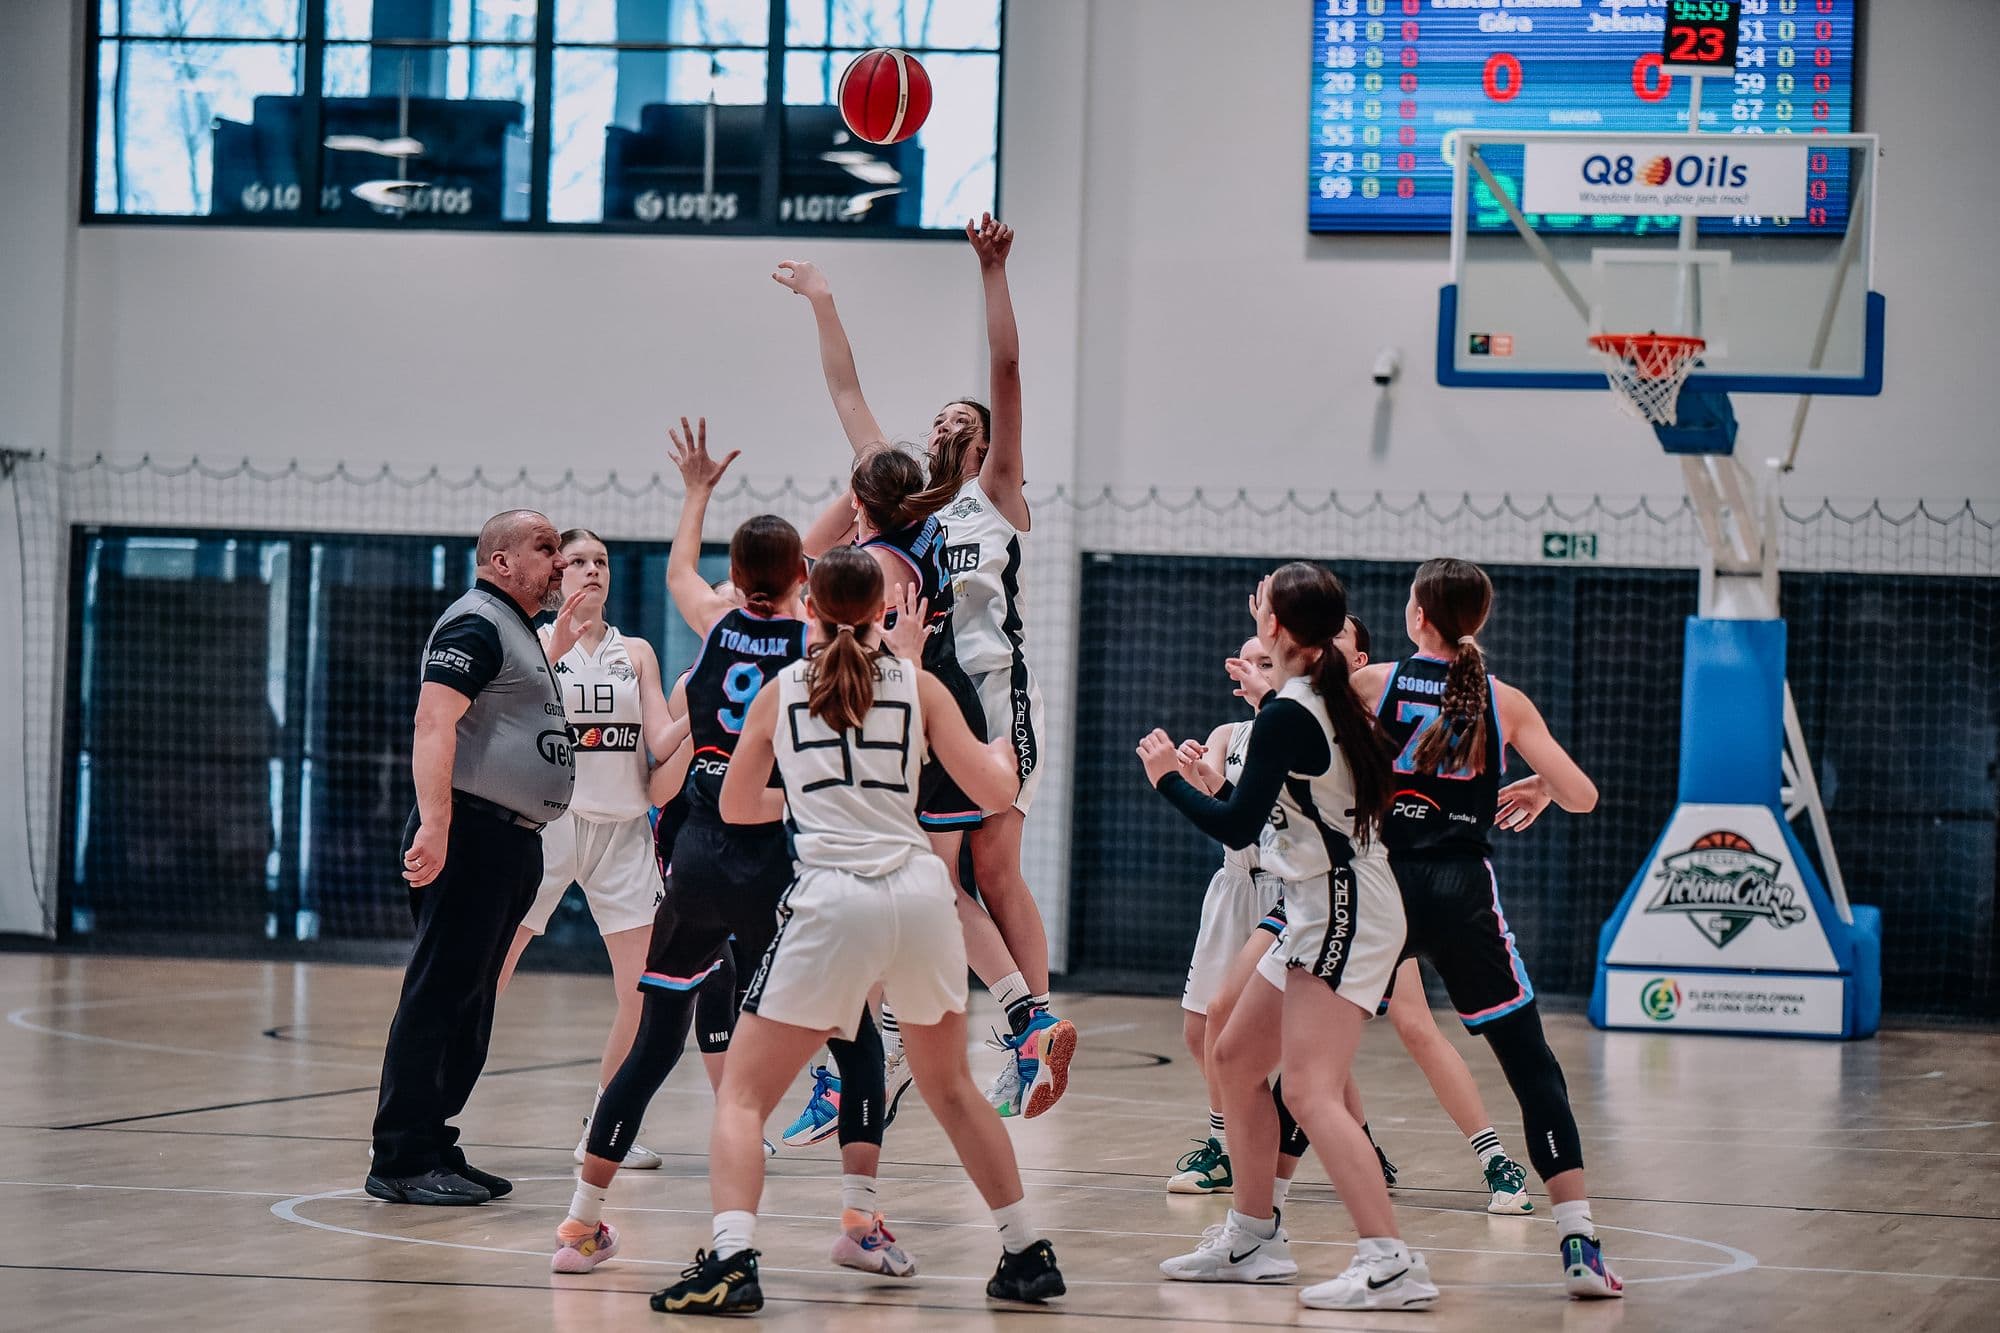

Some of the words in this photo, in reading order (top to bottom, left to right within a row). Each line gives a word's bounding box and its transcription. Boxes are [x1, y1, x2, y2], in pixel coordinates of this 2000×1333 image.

[1674, 0, 1730, 21] 9:59
[1365, 20, 1385, 42] 0
[1738, 20, 1767, 41] 51
[1778, 20, 1796, 41] 0
[1815, 20, 1833, 41] 0
[1669, 26, 1726, 61] 23
[1364, 46, 1384, 68] 0
[1735, 46, 1766, 68] 54
[1777, 46, 1796, 68] 0
[1814, 46, 1832, 68] 0
[1321, 72, 1356, 94] 20
[1363, 72, 1383, 94] 0
[1482, 52, 1523, 103] 0
[1632, 53, 1673, 103] 0
[1776, 73, 1795, 95] 0
[1813, 73, 1831, 95] 0
[1363, 98, 1382, 120] 0
[1732, 98, 1765, 120] 67
[1775, 98, 1793, 121] 0
[1812, 99, 1830, 120] 0
[1320, 125, 1354, 146] 55
[1362, 125, 1381, 146] 0
[1320, 152, 1354, 172] 73
[1361, 152, 1381, 172] 0
[1583, 155, 1634, 186] Q8
[1676, 154, 1748, 188] Oils
[1810, 153, 1828, 174] 0
[1361, 177, 1380, 199] 0
[573, 683, 614, 714] 18
[717, 662, 764, 735] 9
[602, 727, 638, 747] Oils
[1015, 701, 1031, 758] ZIELONA
[695, 758, 729, 777] PGE
[1392, 802, 1429, 820] PGE
[1333, 879, 1349, 939] ZIELONA
[1318, 939, 1342, 978] GÓRA
